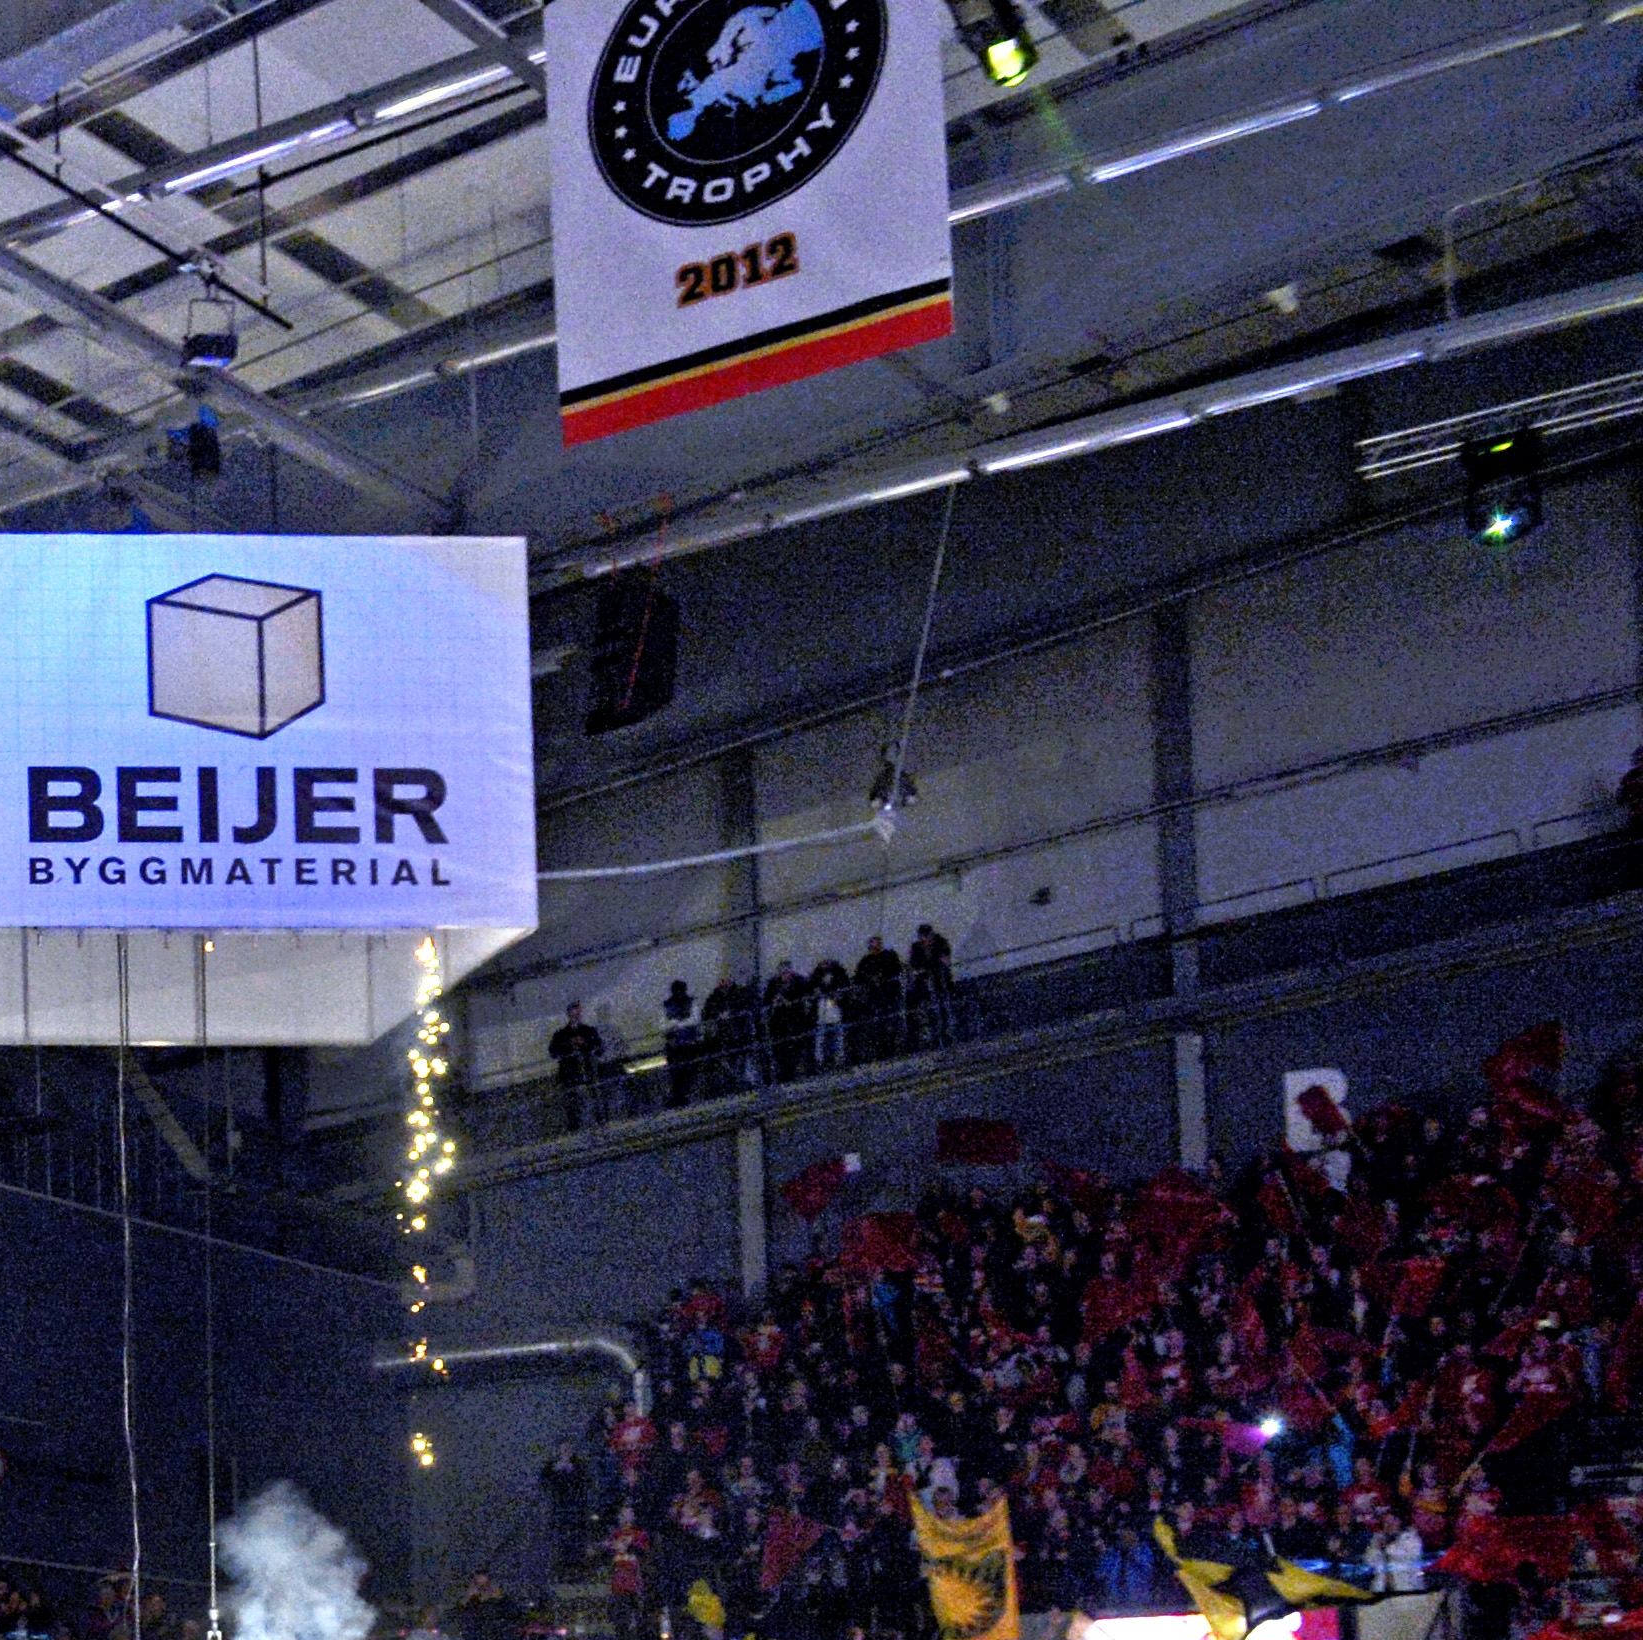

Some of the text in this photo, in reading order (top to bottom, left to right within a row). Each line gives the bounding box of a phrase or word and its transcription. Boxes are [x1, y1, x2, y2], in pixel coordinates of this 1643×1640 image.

[640, 101, 837, 205] TROPHY
[675, 231, 801, 308] 2012
[27, 766, 450, 845] BEIJER
[28, 857, 451, 887] BYGGMATERIAL
